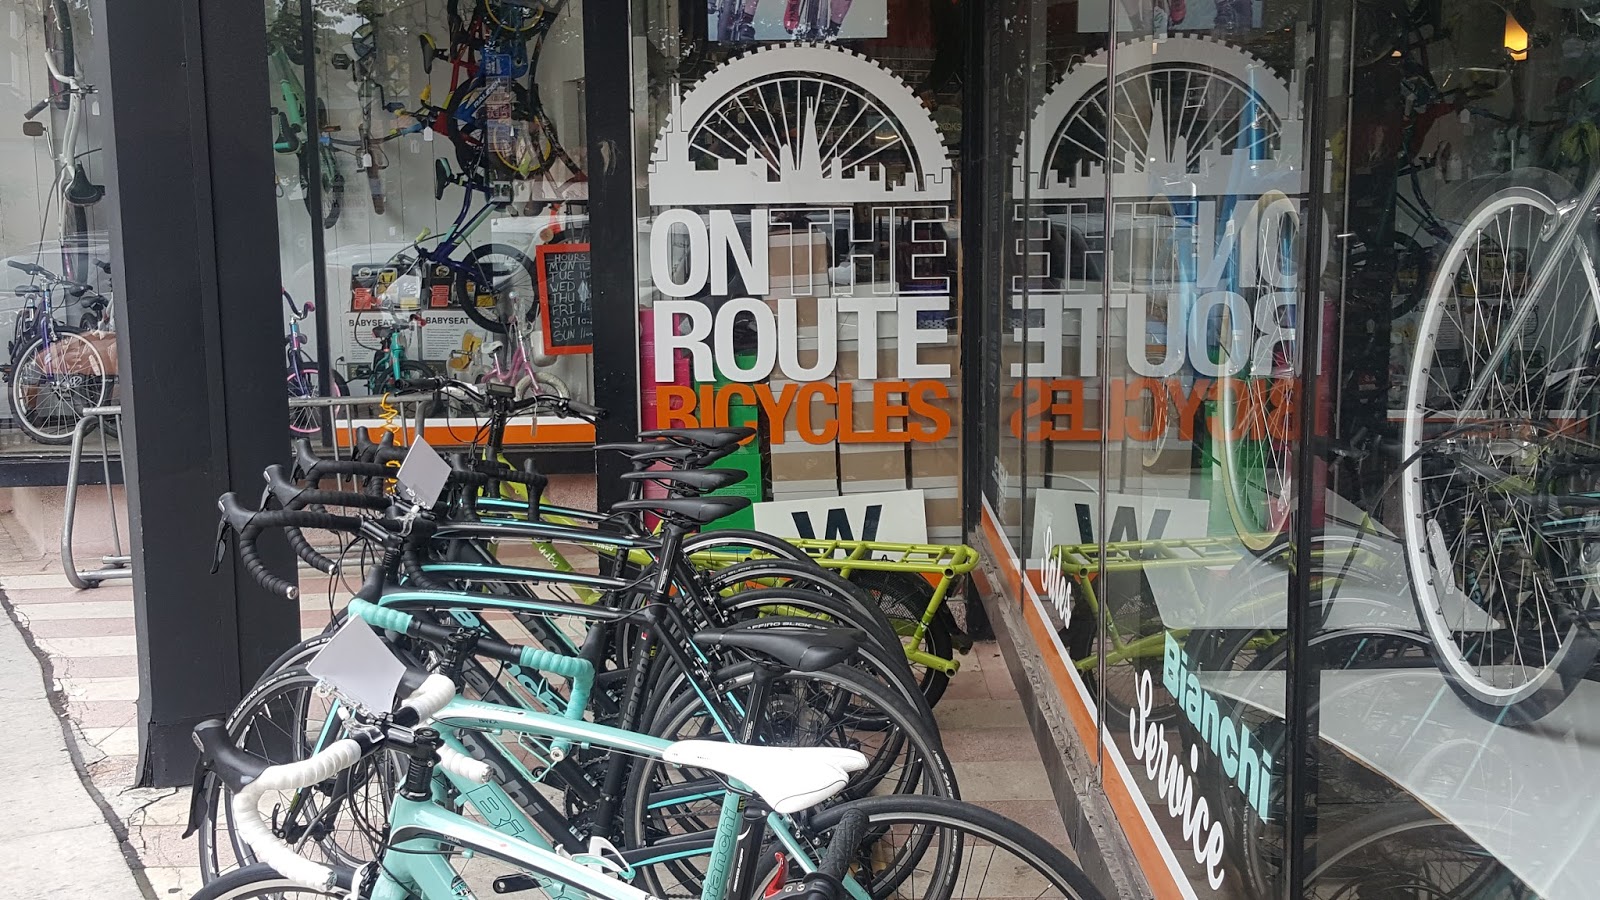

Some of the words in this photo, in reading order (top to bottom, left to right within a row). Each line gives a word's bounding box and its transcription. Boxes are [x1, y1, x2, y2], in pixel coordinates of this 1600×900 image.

[473, 78, 501, 108] RALEIGH
[554, 253, 587, 262] HOURS
[650, 208, 769, 297] ON
[769, 206, 950, 296] THE
[549, 262, 576, 272] MON
[548, 270, 575, 282] TUE
[549, 281, 576, 292] WED
[551, 292, 575, 304] THU
[552, 304, 576, 316] FRI
[426, 316, 470, 325] BABYSEAT
[552, 316, 575, 329] SAT
[552, 330, 576, 342] SUN
[653, 295, 951, 383] ROUTE
[656, 380, 950, 446] BICYCLES
[538, 545, 559, 569] yuba
[1162, 630, 1273, 825] Bianchi
[1129, 669, 1225, 891] Service
[704, 806, 738, 900] ianchi
